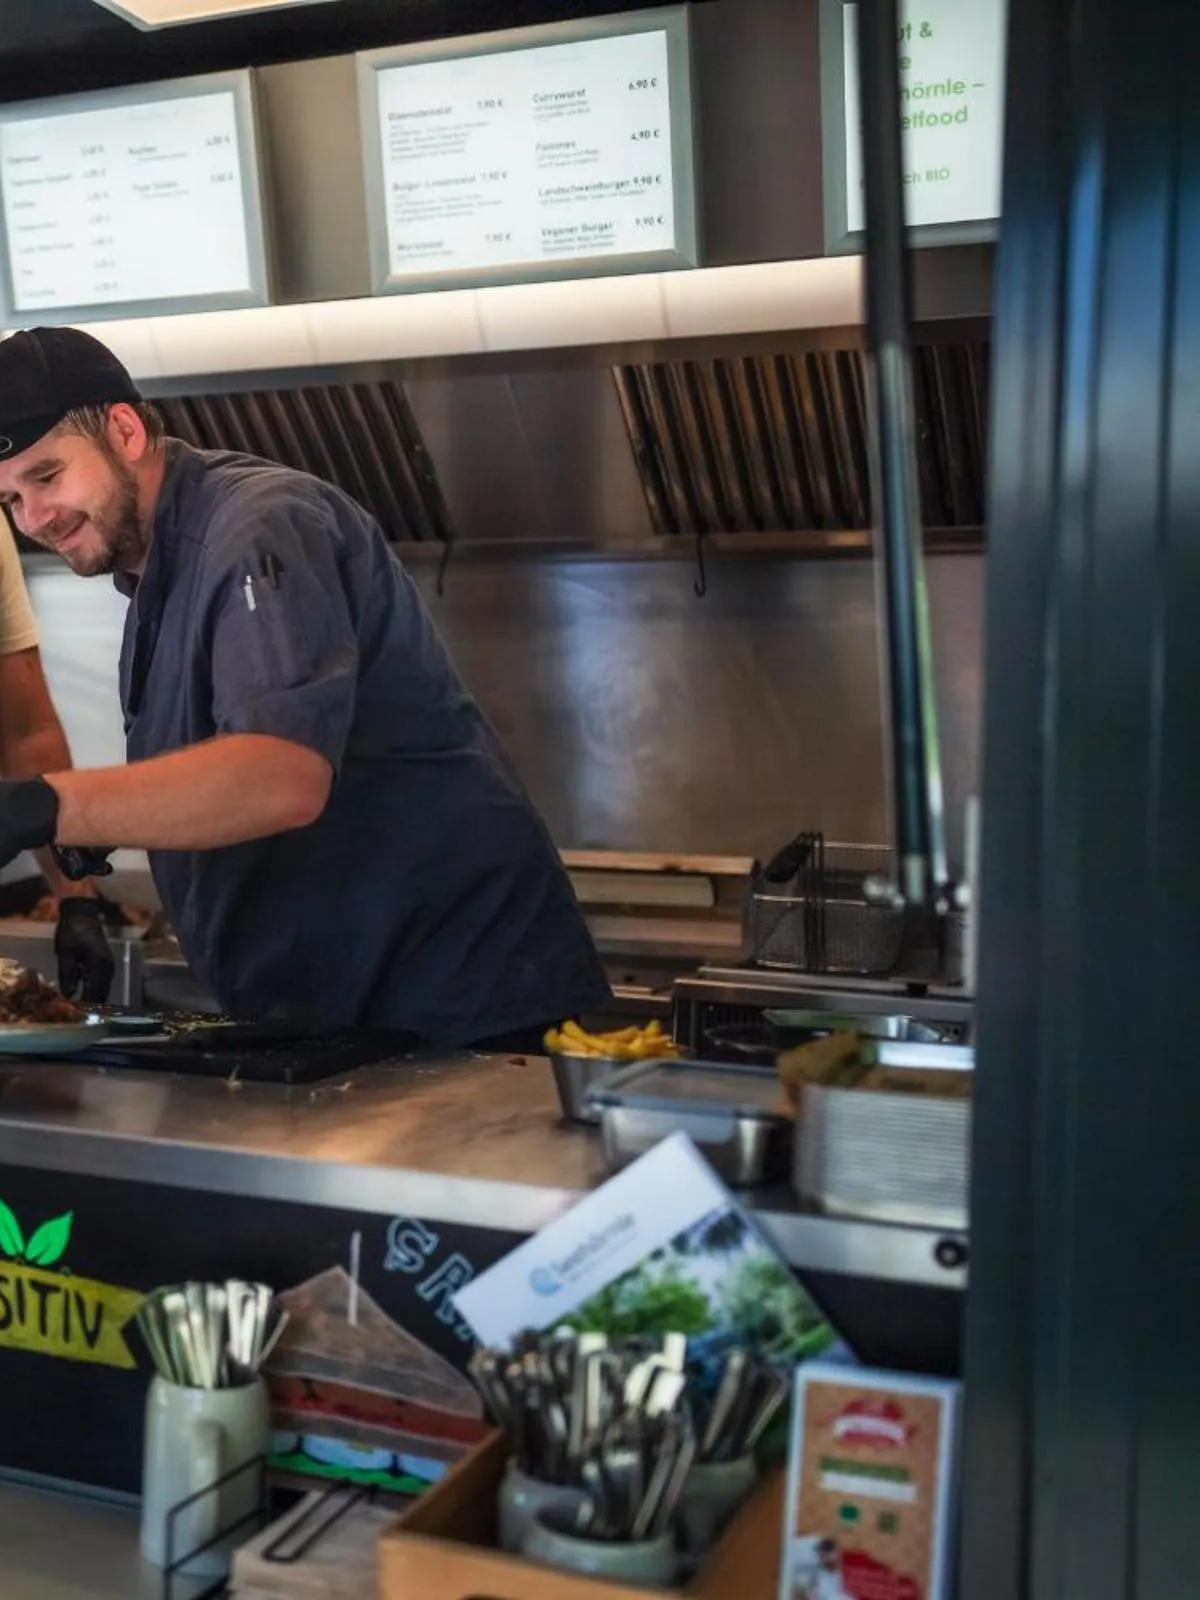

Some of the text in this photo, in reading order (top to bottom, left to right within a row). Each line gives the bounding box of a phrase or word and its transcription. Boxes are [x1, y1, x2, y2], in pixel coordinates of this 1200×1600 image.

[920, 21, 932, 38] &
[532, 88, 586, 103] Currywurst
[901, 79, 966, 100] hörnle
[901, 106, 968, 129] etfood
[926, 168, 951, 182] BIO
